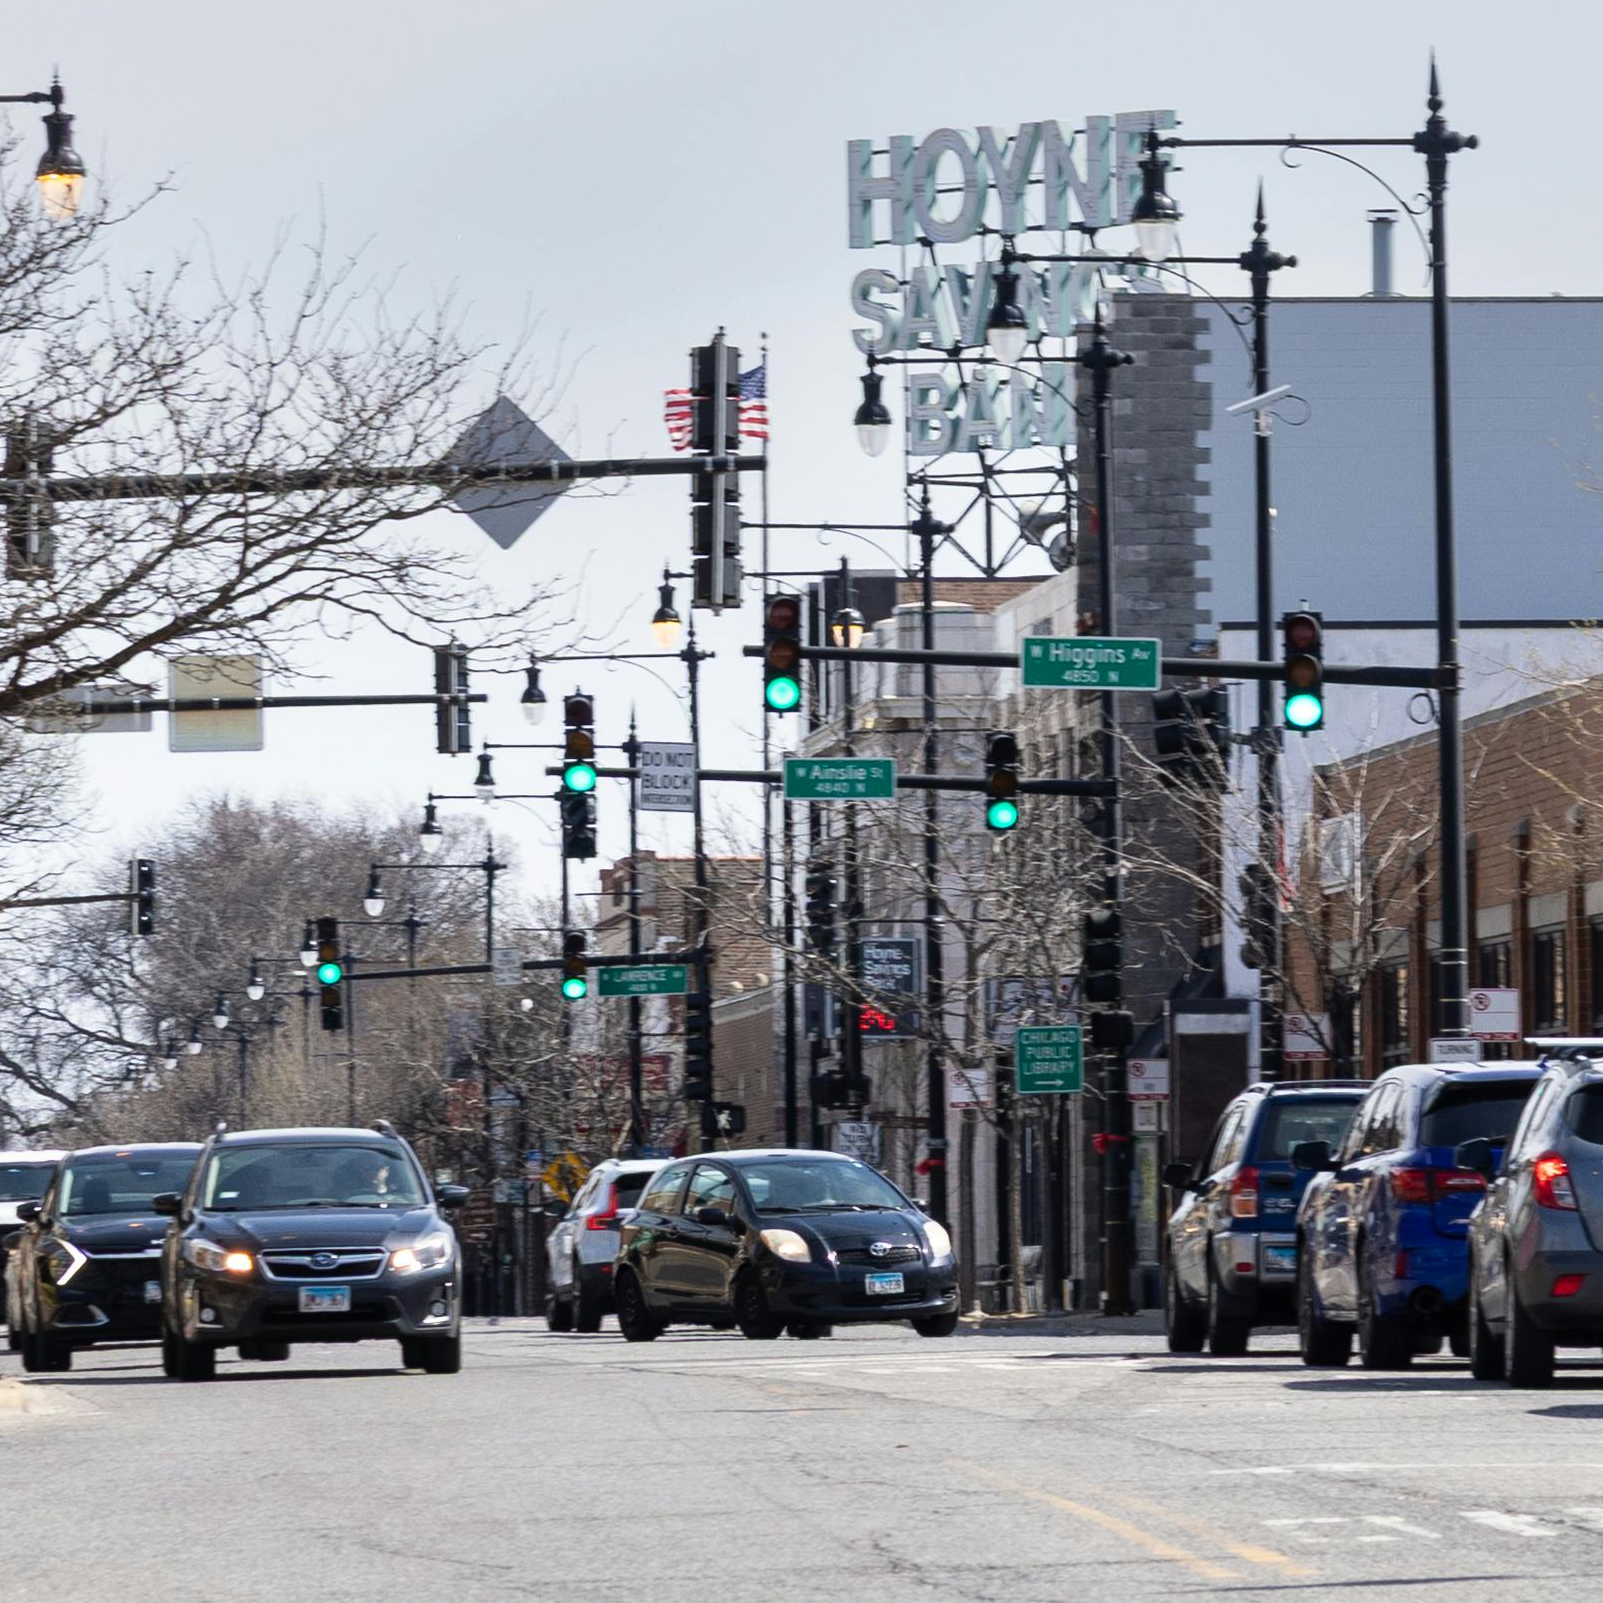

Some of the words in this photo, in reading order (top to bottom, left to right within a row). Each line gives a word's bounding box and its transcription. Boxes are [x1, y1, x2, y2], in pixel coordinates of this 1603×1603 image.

[1029, 645, 1044, 658] W
[1048, 643, 1127, 669] Higgins
[1108, 671, 1119, 683] N
[642, 751, 663, 767] DO
[666, 752, 695, 768] NOT
[809, 764, 868, 780] Ainslie
[641, 773, 693, 790] BLOCK
[612, 969, 667, 983] LAWRENCE
[1020, 1030, 1077, 1044] CHICAGO
[1025, 1046, 1072, 1059] PUBLIC
[1021, 1061, 1076, 1075] LIBRARY
